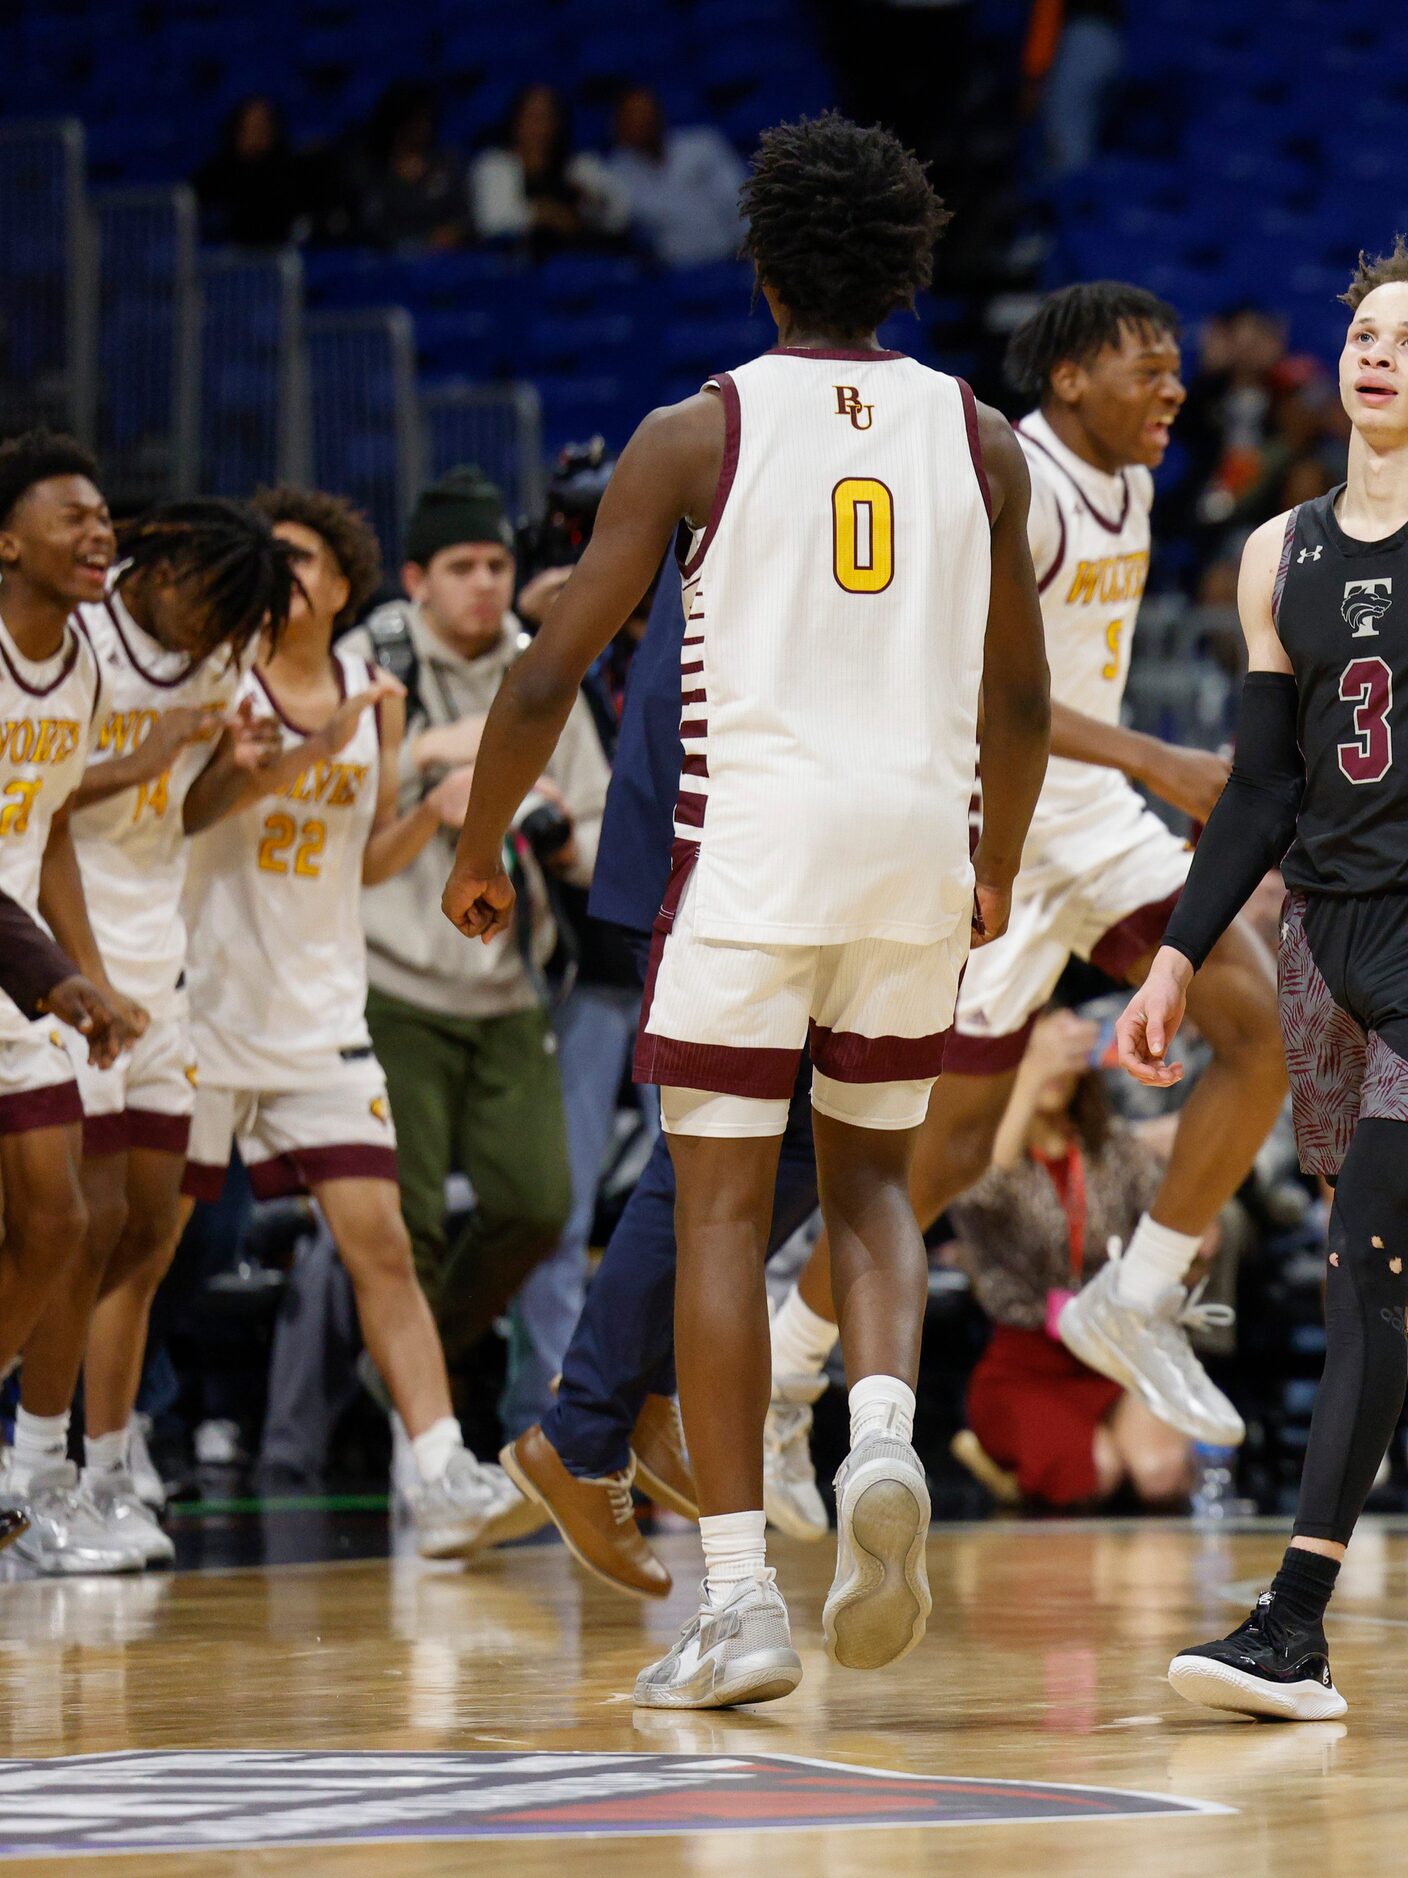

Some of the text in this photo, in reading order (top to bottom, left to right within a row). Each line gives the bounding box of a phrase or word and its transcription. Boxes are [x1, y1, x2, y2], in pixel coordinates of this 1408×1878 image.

[831, 477, 895, 594] 0
[1337, 656, 1393, 784] 3
[258, 812, 326, 878] 22
